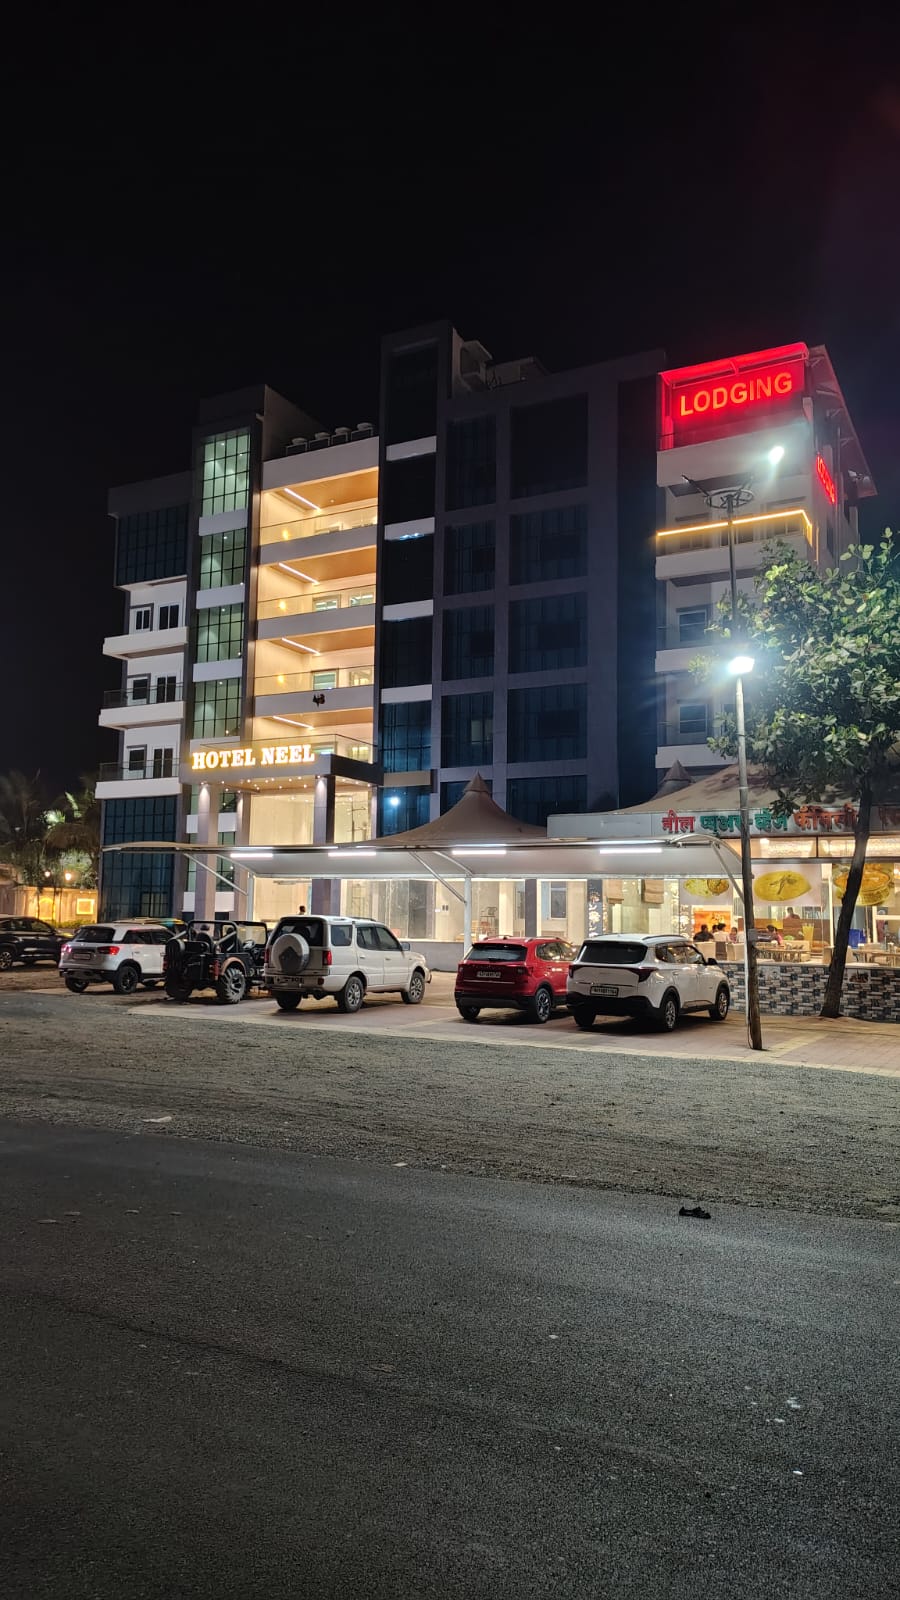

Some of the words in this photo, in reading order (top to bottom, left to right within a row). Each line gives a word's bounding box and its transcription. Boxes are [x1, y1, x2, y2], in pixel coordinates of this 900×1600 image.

[680, 372, 793, 417] LODGING
[191, 748, 256, 770] HOTEL
[260, 744, 315, 765] NEEL
[662, 808, 696, 833] नील
